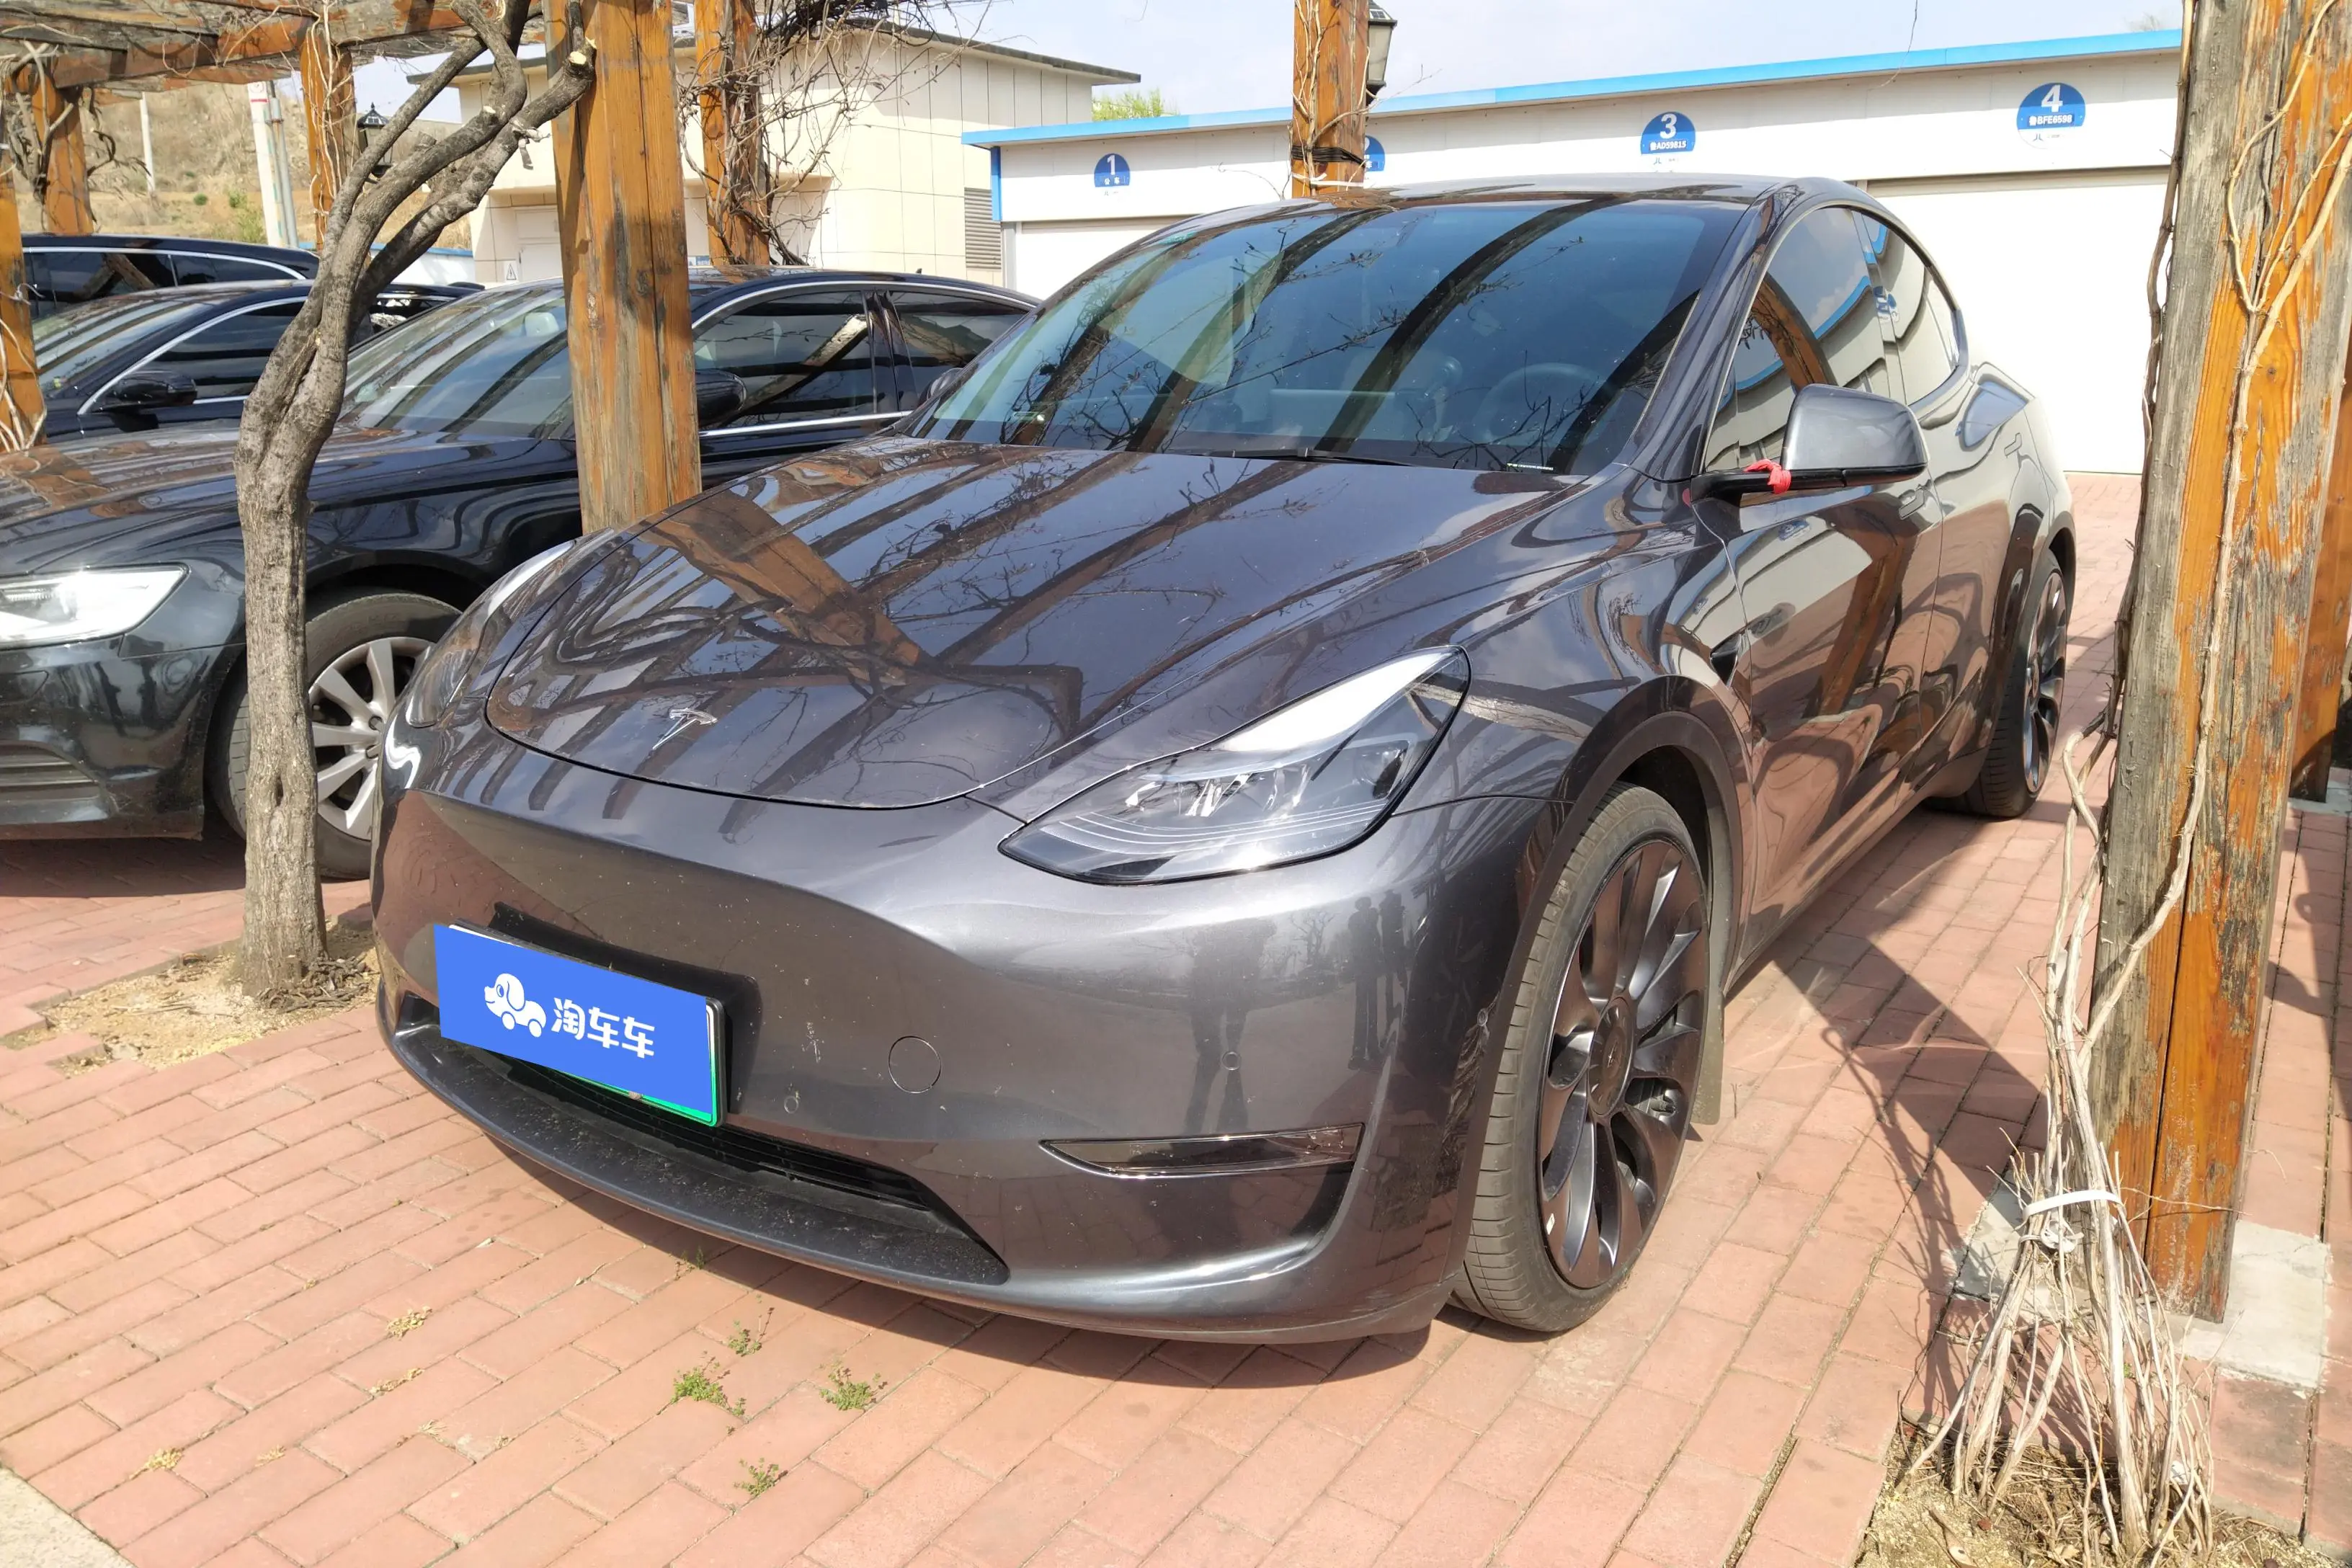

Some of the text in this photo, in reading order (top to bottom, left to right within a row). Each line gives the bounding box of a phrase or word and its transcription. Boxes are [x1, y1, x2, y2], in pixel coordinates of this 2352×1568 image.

[2041, 84, 2063, 112] 4
[1660, 113, 1677, 139] 3
[1107, 154, 1116, 176] 1
